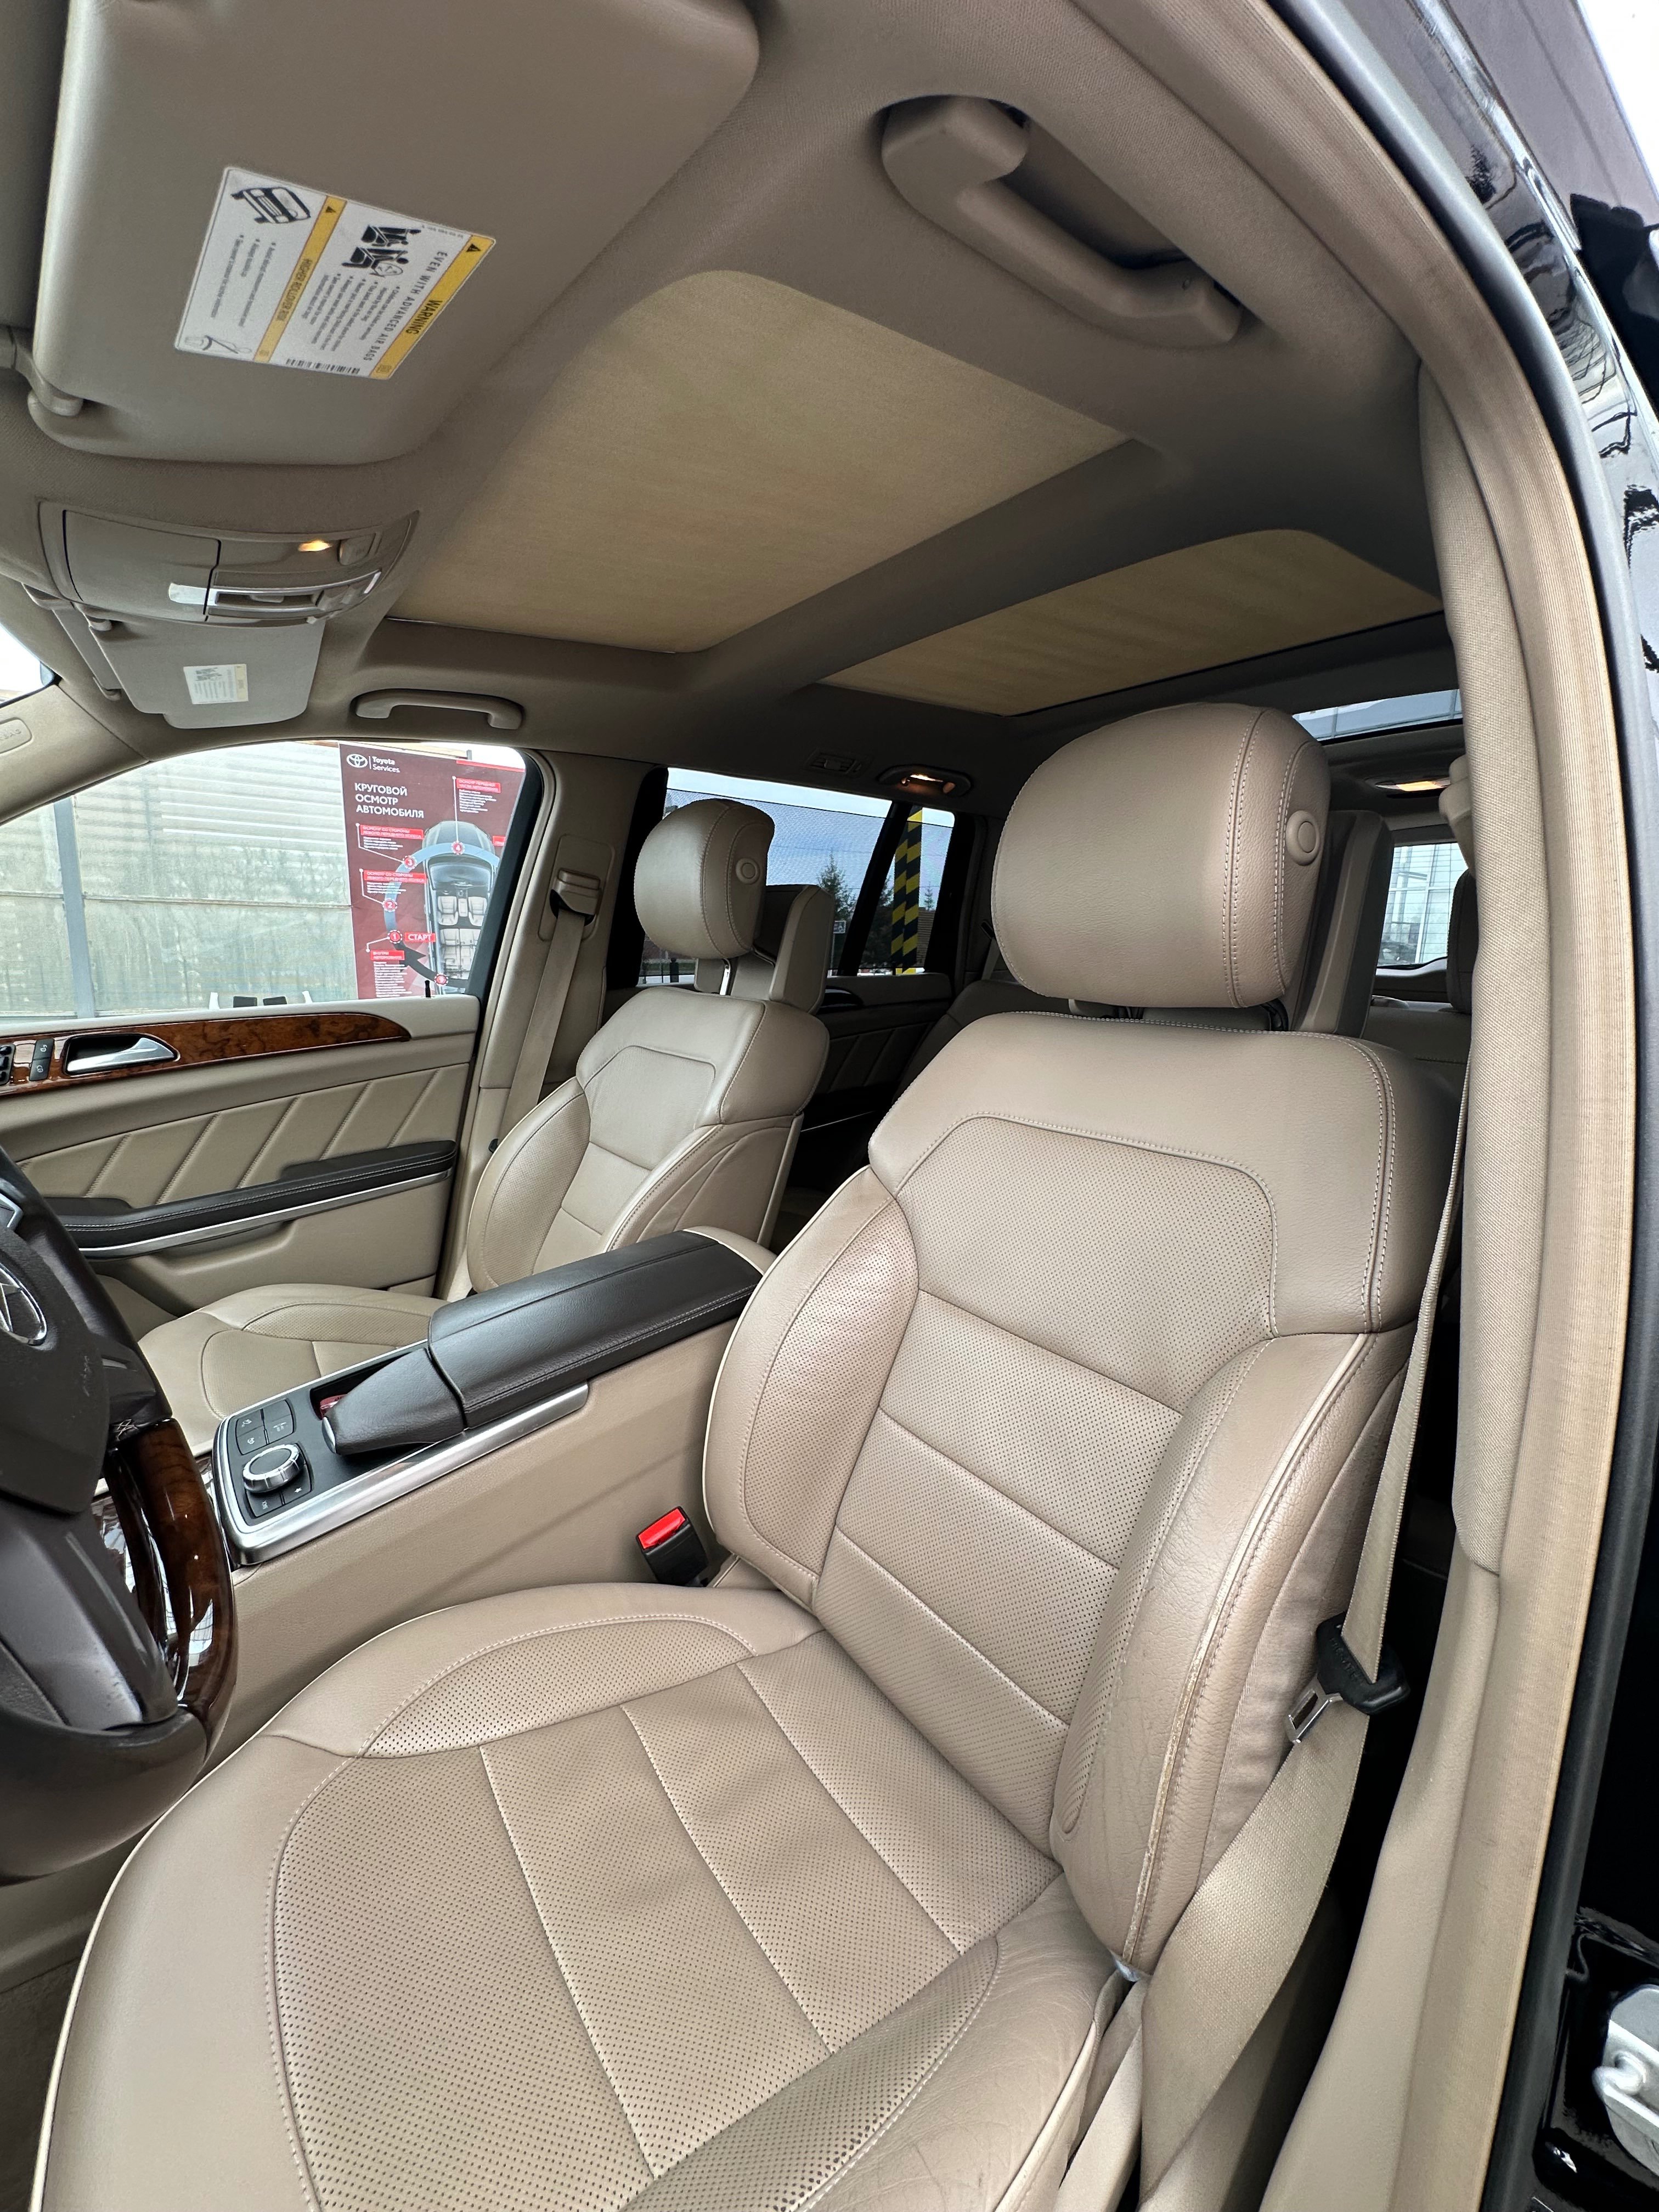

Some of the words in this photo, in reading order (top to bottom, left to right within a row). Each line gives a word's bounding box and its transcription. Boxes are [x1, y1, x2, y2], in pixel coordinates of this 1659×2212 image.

[425, 251, 448, 273] EVEN
[410, 275, 431, 295] WITH
[383, 296, 415, 332] ADVANCED
[405, 300, 443, 335] WARNING
[374, 333, 388, 344] AIR
[363, 345, 380, 361] BAGS
[372, 757, 396, 765] Toyota
[373, 764, 400, 773] Services
[354, 782, 408, 796] КРУГОВОЙ
[355, 793, 398, 805] ОСМОТР
[356, 804, 425, 819] АВТОМОБИЛЯ
